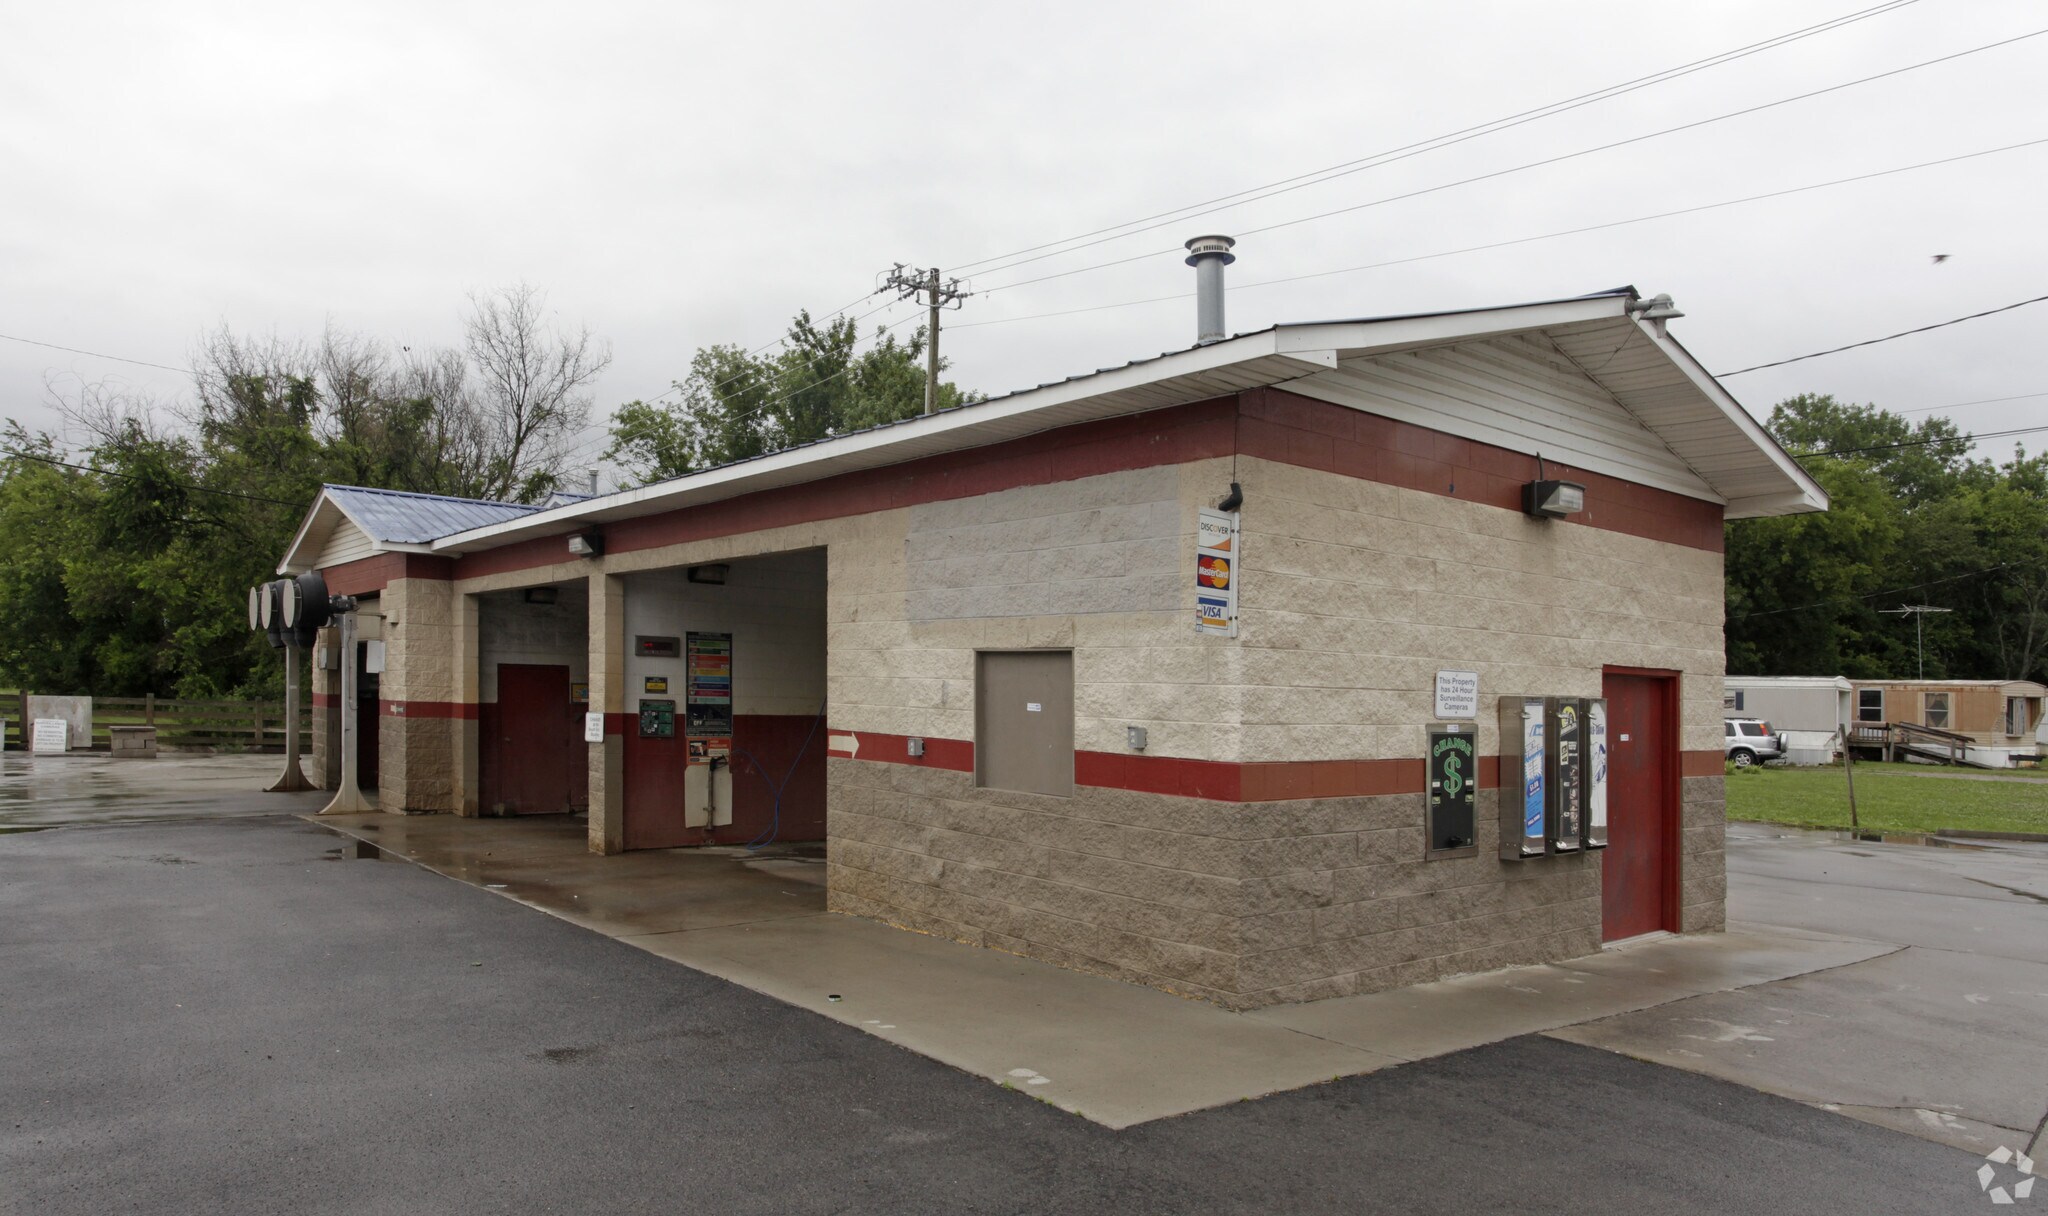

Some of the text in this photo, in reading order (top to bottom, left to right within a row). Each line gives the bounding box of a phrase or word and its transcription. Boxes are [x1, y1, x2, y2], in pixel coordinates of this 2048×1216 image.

[1200, 522, 1229, 535] DISCOVER
[1198, 566, 1229, 579] MasterCard
[1203, 605, 1222, 618] VISA
[1439, 676, 1476, 687] This Property
[1452, 686, 1459, 694] 24
[1440, 694, 1474, 702] Surveillance
[1443, 702, 1469, 711] Cameras
[1433, 737, 1473, 757] CHANGE
